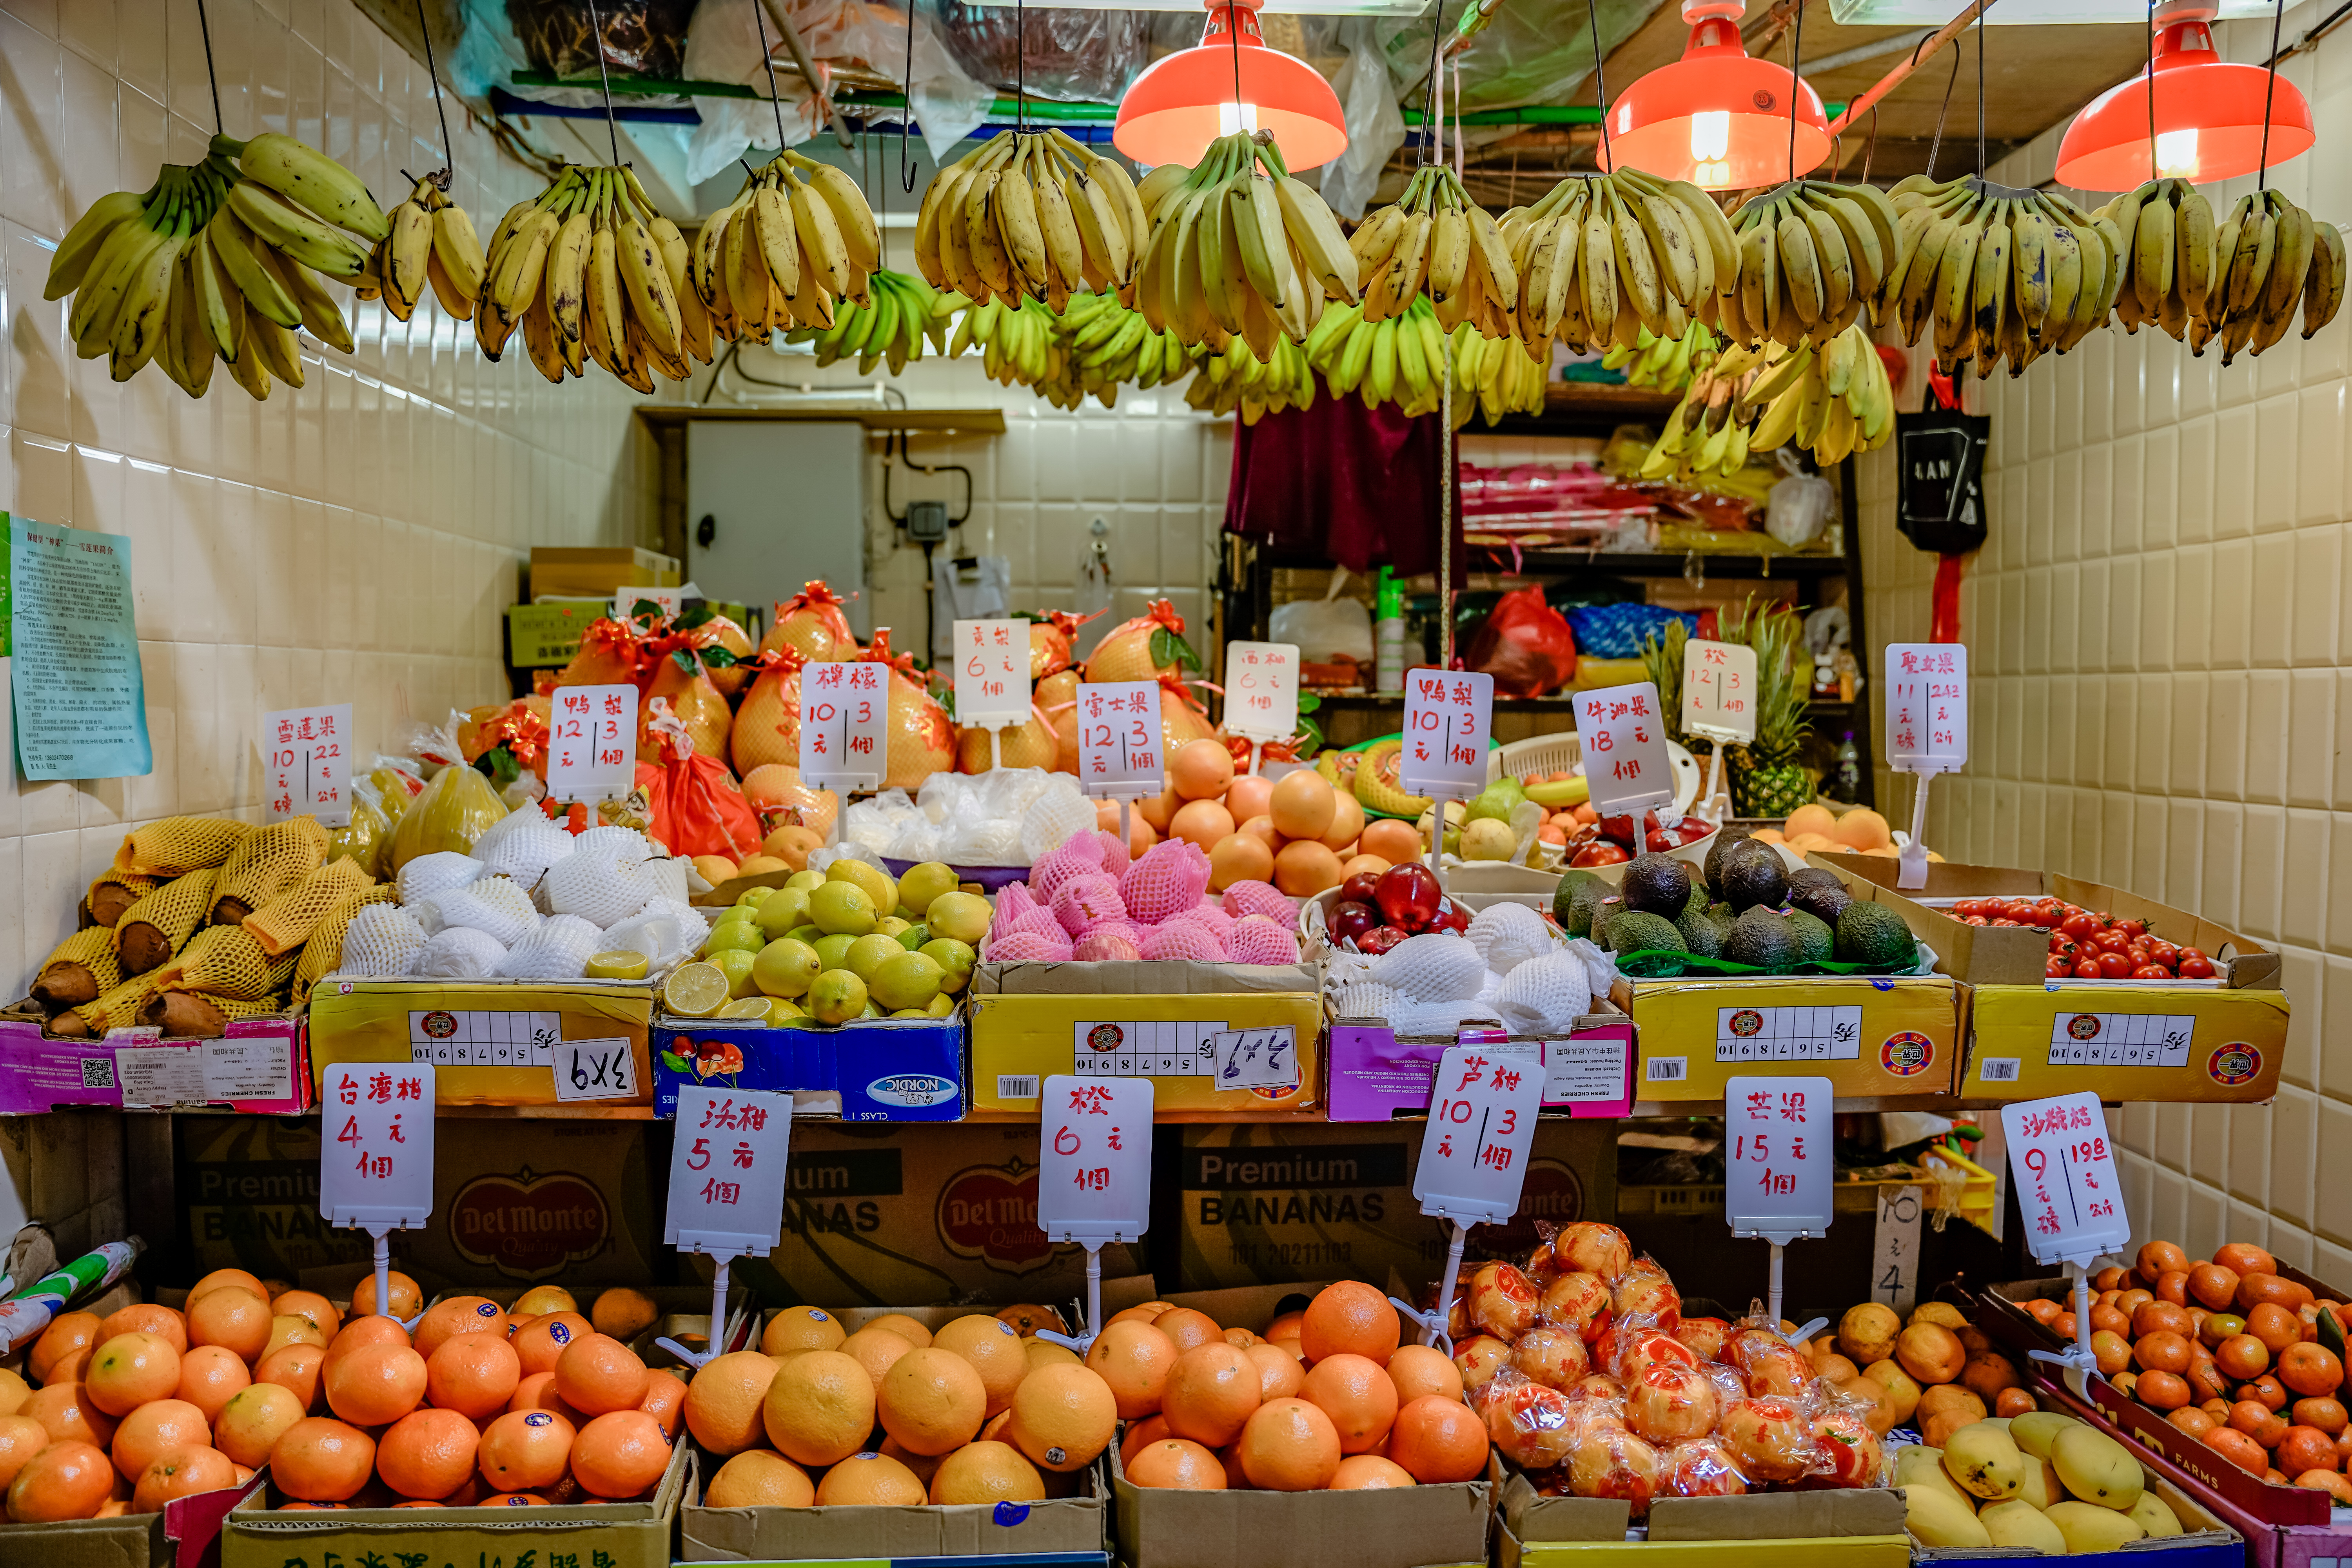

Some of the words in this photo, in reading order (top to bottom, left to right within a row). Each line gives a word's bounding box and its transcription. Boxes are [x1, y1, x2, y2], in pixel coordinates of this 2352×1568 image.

[968, 655, 985, 677] 6
[1003, 656, 1013, 671] 元
[1240, 673, 1257, 688] 6
[1691, 669, 1711, 684] 12
[1728, 673, 1740, 688] 3
[1898, 684, 1913, 699] 11
[810, 704, 835, 722] 10
[857, 702, 871, 723] 3
[1085, 691, 1148, 718] 富士果
[1938, 707, 1948, 720] 元
[1413, 710, 1439, 730] 10
[1460, 713, 1474, 735] 3
[1900, 708, 1912, 724] 元
[557, 720, 583, 738] 12
[603, 721, 617, 739] 3
[1085, 725, 1114, 747] 12
[1131, 720, 1148, 746] 3
[814, 734, 826, 753] 元
[1591, 731, 1613, 751] 18
[1635, 727, 1648, 742] 元
[274, 750, 294, 767] 10
[314, 744, 340, 760] 22
[562, 752, 573, 766] 元
[1416, 741, 1429, 761] 元
[1093, 756, 1106, 772] 元
[1131, 753, 1154, 770] 個
[278, 774, 288, 788] 元
[322, 767, 330, 778] 元
[533, 1029, 558, 1049] 秀
[1833, 1023, 1857, 1042] 秀
[414, 1049, 431, 1058] 10
[439, 1049, 446, 1058] 9
[458, 1049, 466, 1058] 8
[479, 1049, 486, 1058] 7
[499, 1049, 507, 1059] 6
[518, 1049, 525, 1059] 5
[1719, 1045, 1734, 1054] 10
[1742, 1045, 1749, 1054] 9
[1760, 1045, 1768, 1054] 8
[1779, 1044, 1787, 1053] 7
[1799, 1044, 1807, 1053] 6
[1817, 1044, 1824, 1053] 5
[1891, 1049, 1921, 1059] 世界一
[2219, 1059, 2249, 1070] 世界一
[886, 1078, 940, 1092] NORDIC
[1069, 1086, 1113, 1115] 橙
[1747, 1091, 1806, 1122] 芒果
[700, 1099, 768, 1131] 沃柑
[860, 1111, 888, 1120] CLASS
[1440, 1099, 1472, 1123] 10
[338, 1115, 363, 1148] 4
[389, 1114, 405, 1143] 元
[1497, 1110, 1516, 1134] 3
[1054, 1126, 1081, 1155] 6
[1108, 1127, 1122, 1150] 元
[1438, 1135, 1452, 1157] 元
[1736, 1135, 1768, 1162] 15
[1792, 1137, 1806, 1160] 元
[687, 1138, 711, 1170] 5
[733, 1142, 754, 1169] 元
[1481, 1144, 1512, 1171] 個
[356, 1151, 392, 1178] 個
[1200, 1155, 1358, 1184] Premium
[2025, 1149, 2046, 1181] 9
[1074, 1167, 1109, 1190] 個
[1759, 1168, 1796, 1196] 個
[2085, 1172, 2098, 1189] 元
[700, 1178, 740, 1205] 個
[2036, 1185, 2051, 1203] 元
[949, 1200, 995, 1227] Del
[1200, 1192, 1385, 1226] BANANAS
[1883, 1197, 1918, 1223] 10
[463, 1208, 507, 1234] Del
[510, 1205, 597, 1232] Monte
[989, 1229, 1046, 1248] Quality
[1878, 1264, 1904, 1304] 4
[2176, 1453, 2218, 1489] FARMS
